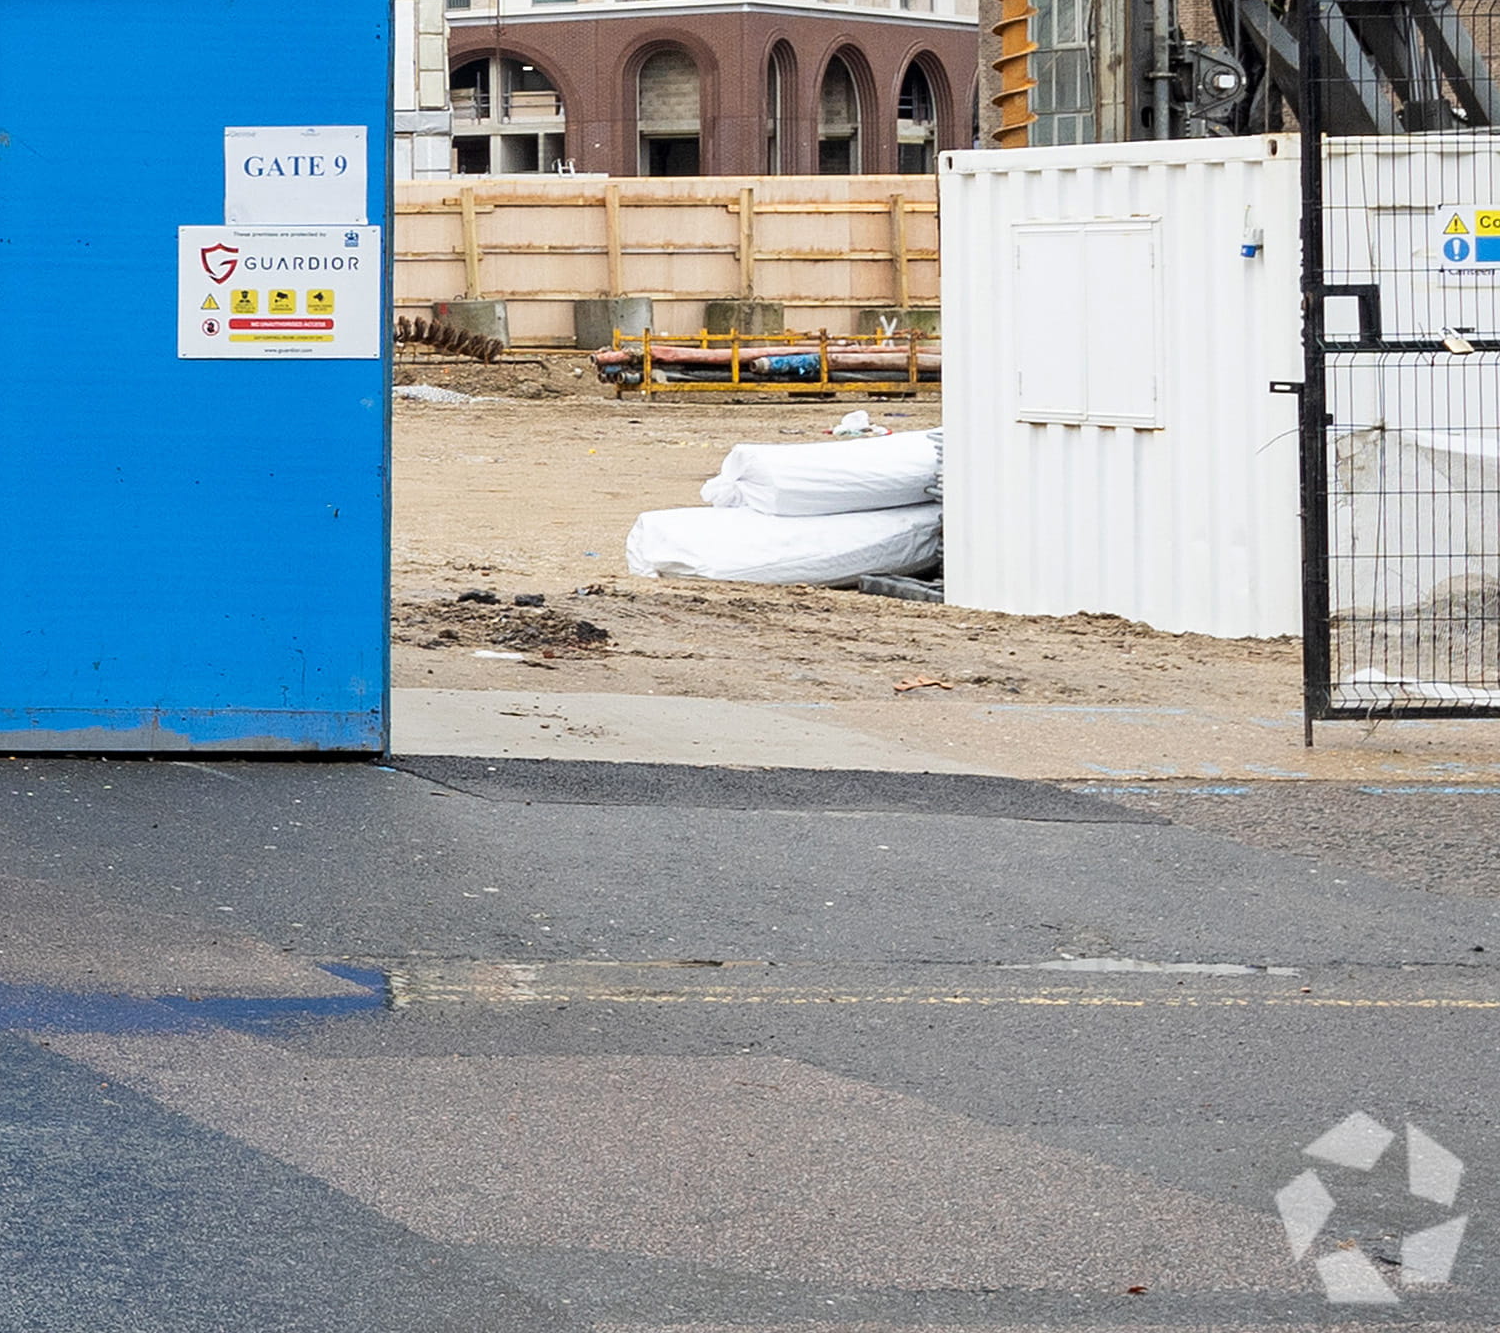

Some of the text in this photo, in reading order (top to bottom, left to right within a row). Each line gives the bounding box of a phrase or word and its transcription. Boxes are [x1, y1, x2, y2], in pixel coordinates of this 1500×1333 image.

[243, 155, 348, 177] GATE 9
[244, 256, 360, 271] GUARDIOR
